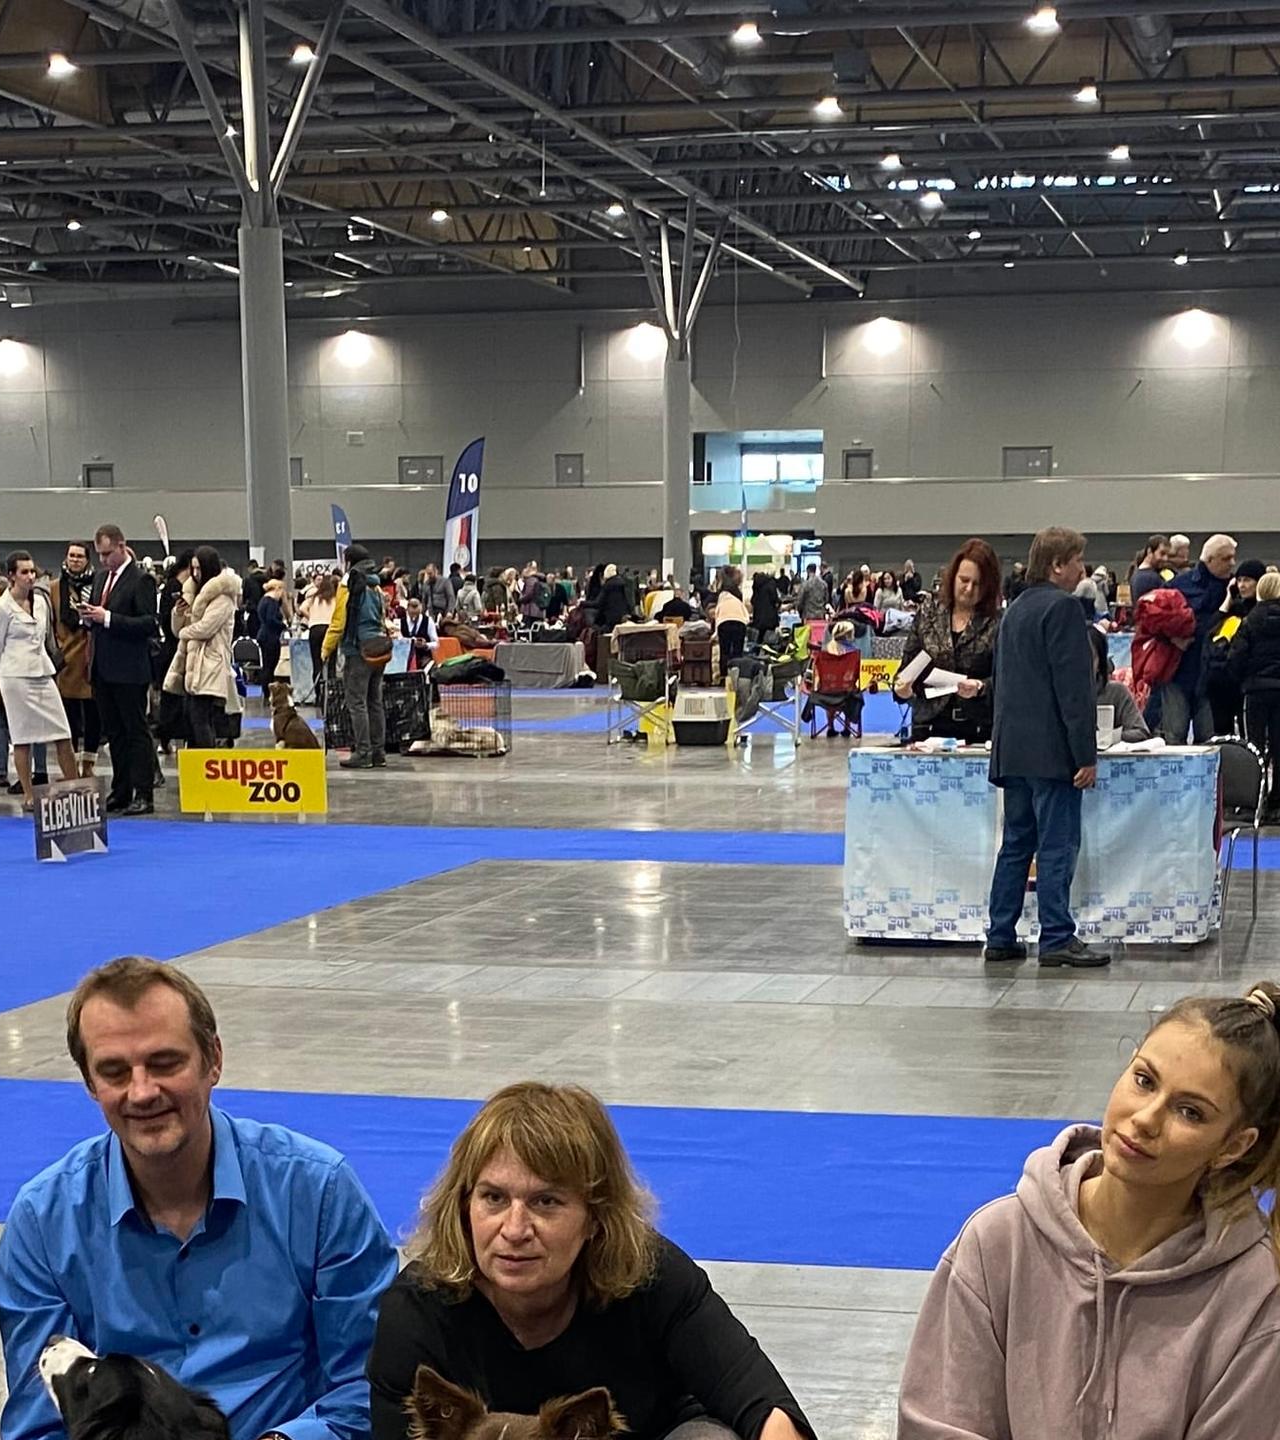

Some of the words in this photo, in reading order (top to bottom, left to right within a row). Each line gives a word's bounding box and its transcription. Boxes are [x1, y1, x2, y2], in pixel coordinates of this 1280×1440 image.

[459, 473, 479, 493] 10
[861, 663, 887, 675] uper
[204, 759, 289, 787] super
[248, 782, 301, 803] zoo
